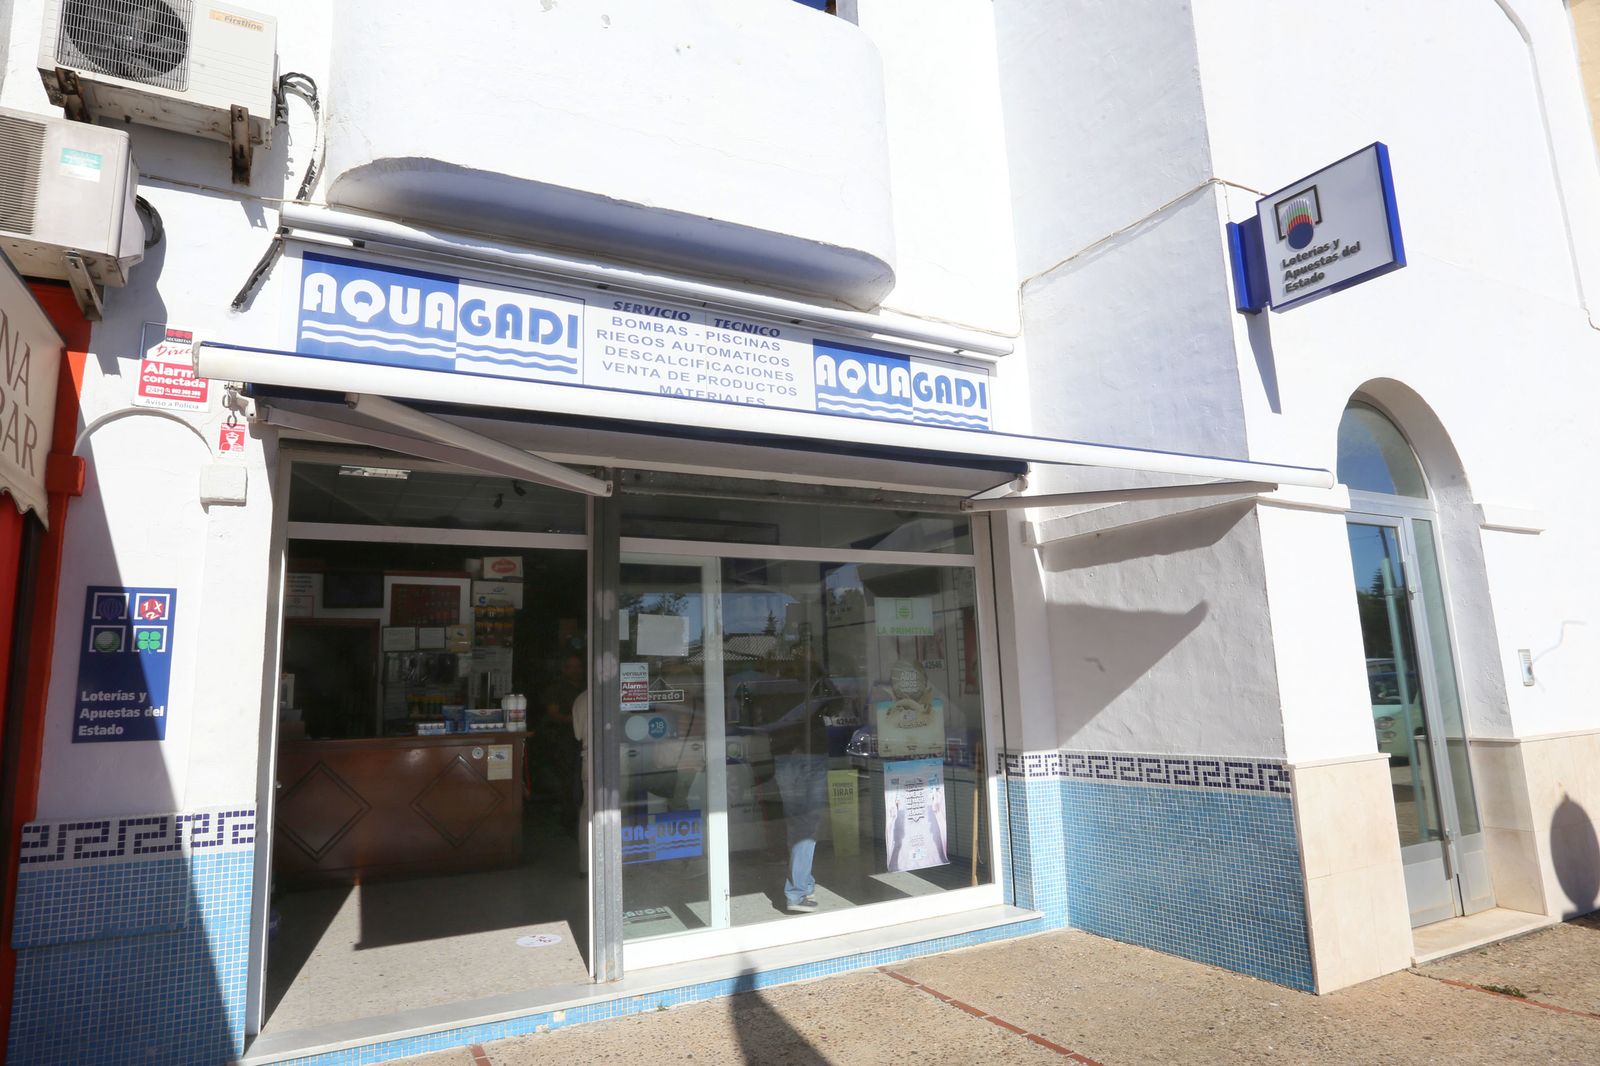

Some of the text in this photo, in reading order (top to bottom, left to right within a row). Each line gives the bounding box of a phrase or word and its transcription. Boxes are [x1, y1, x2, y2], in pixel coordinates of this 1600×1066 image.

[1282, 238, 1340, 269] Loterías y
[1285, 241, 1361, 281] Apuestas del
[1285, 270, 1325, 293] Estado
[613, 300, 781, 338] SERVICIO TECNICO
[612, 316, 688, 337] BOMBAS
[706, 331, 781, 351] PISCINAS
[156, 344, 193, 357] Direc
[597, 329, 790, 367] RIEGOS AUTOMATICOS
[144, 362, 195, 379] Alarm
[605, 345, 794, 382] DESCALCIFICACIONES
[142, 375, 206, 388] conectada
[602, 360, 798, 396] VENTA DE PRODUCTOS
[145, 398, 166, 406] Aviso
[0, 386, 37, 477] AR
[81, 689, 147, 703] Loterías y
[79, 705, 164, 721] Apuestas del
[78, 723, 124, 736] Estado
